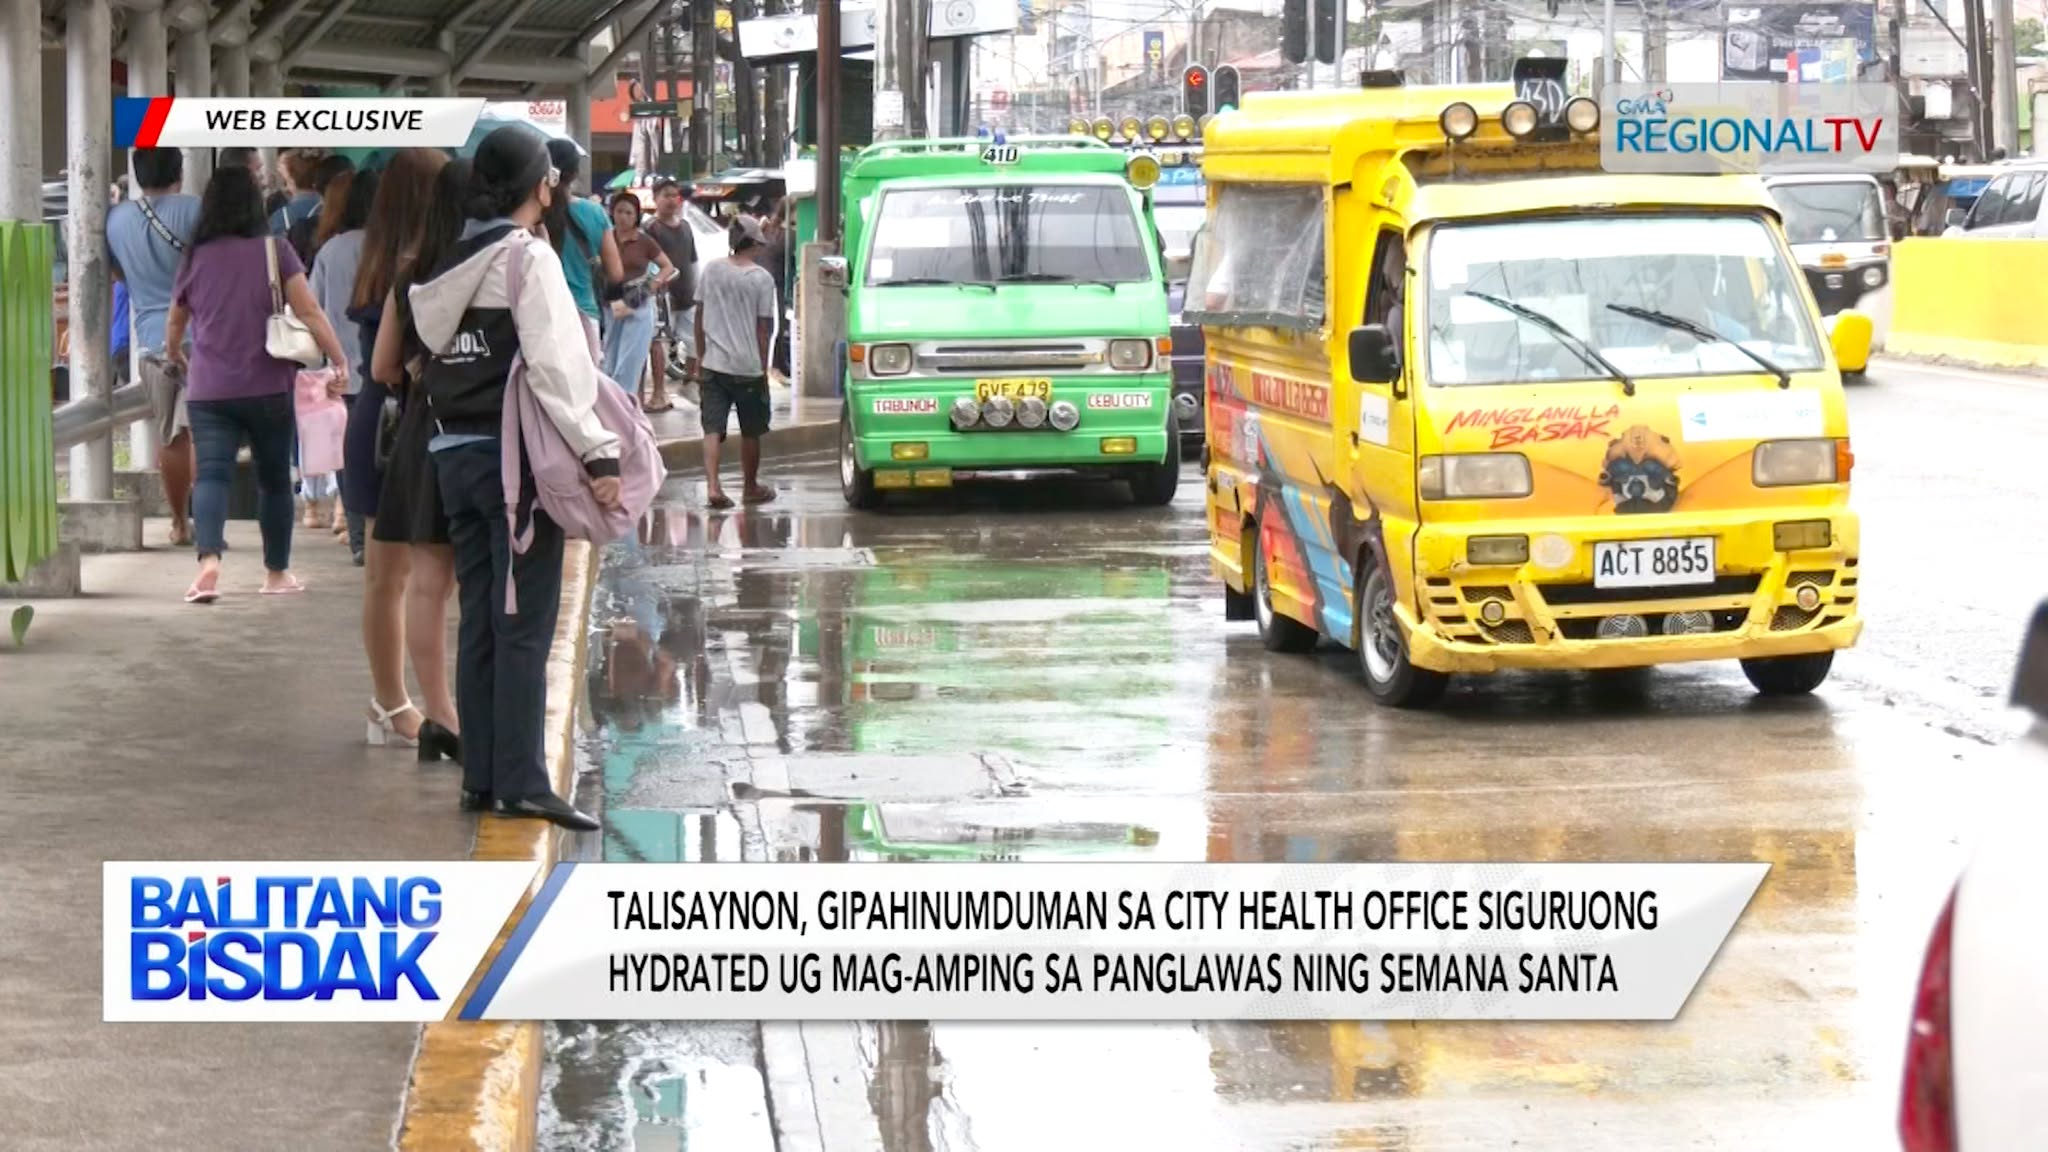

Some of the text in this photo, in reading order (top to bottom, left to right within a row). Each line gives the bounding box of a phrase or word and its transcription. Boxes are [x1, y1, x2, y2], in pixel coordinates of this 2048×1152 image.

[1087, 394, 1150, 407] CEBU CITY
[1445, 405, 1620, 434] MINGLANILLA
[1489, 420, 1611, 449] BASAK
[1600, 545, 1708, 575] ACT 8855
